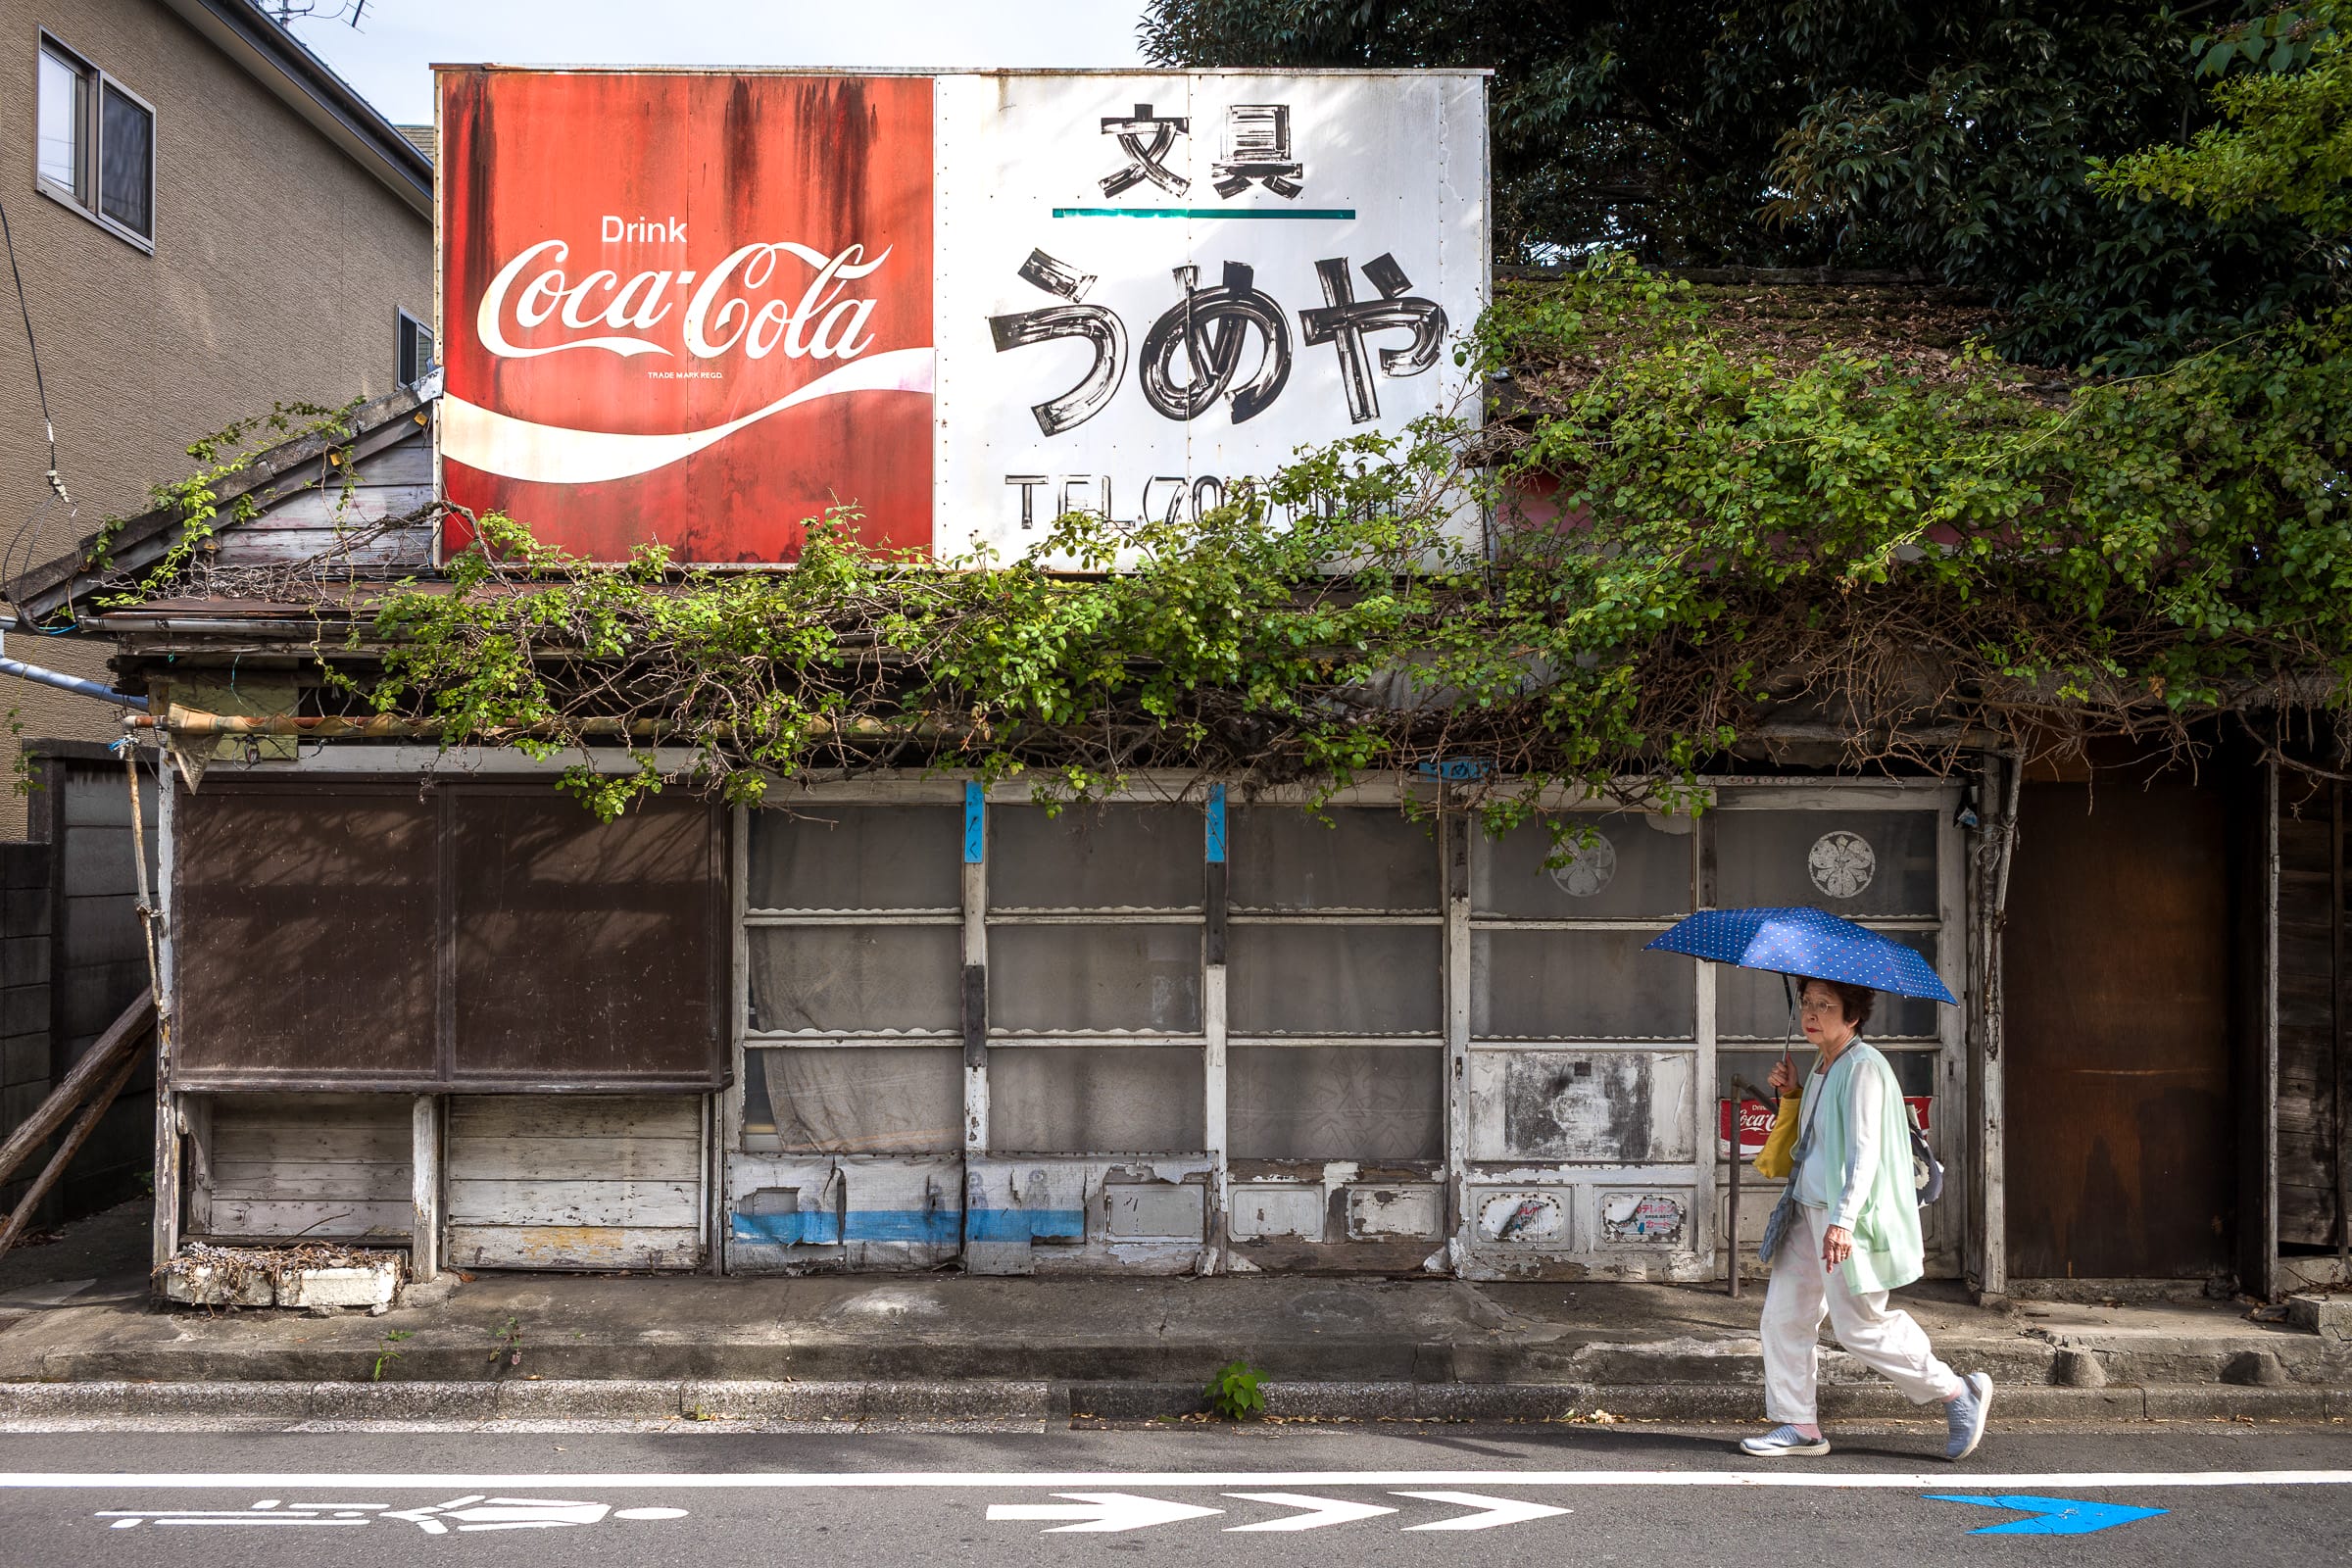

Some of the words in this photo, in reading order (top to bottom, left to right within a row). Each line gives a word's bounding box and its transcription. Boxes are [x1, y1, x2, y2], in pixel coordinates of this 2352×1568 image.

[1099, 104, 1303, 199] 文具
[601, 216, 688, 243] Drink
[476, 239, 894, 360] Coca-Cola
[989, 247, 1448, 437] うめや
